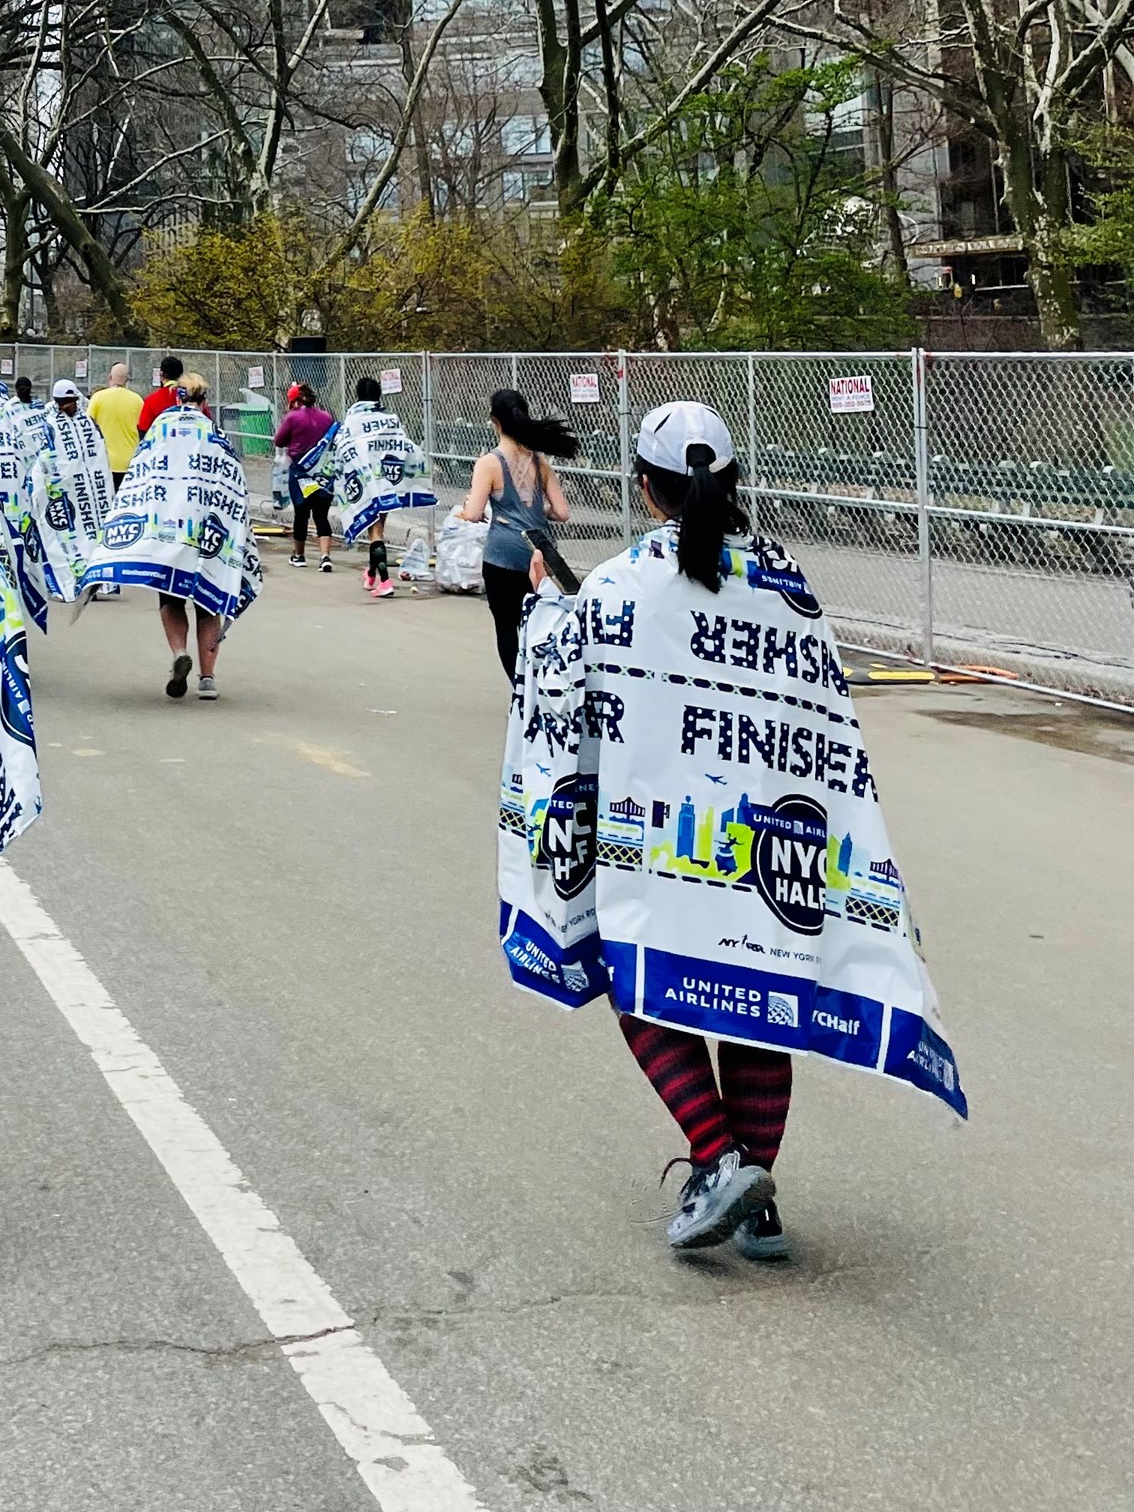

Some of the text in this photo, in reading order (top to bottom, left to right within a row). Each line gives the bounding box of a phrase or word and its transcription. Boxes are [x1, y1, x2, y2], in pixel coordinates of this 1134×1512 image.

[831, 379, 870, 394] NATIONAL
[73, 473, 97, 541] FINISHER
[107, 524, 139, 539] NYC
[108, 534, 135, 547] HALF
[549, 799, 574, 809] TED
[753, 814, 791, 830] UNITED
[525, 940, 558, 972] UNITED
[770, 948, 790, 959] NEW
[683, 976, 762, 1002] UNITED
[665, 988, 761, 1018] AIRLINES
